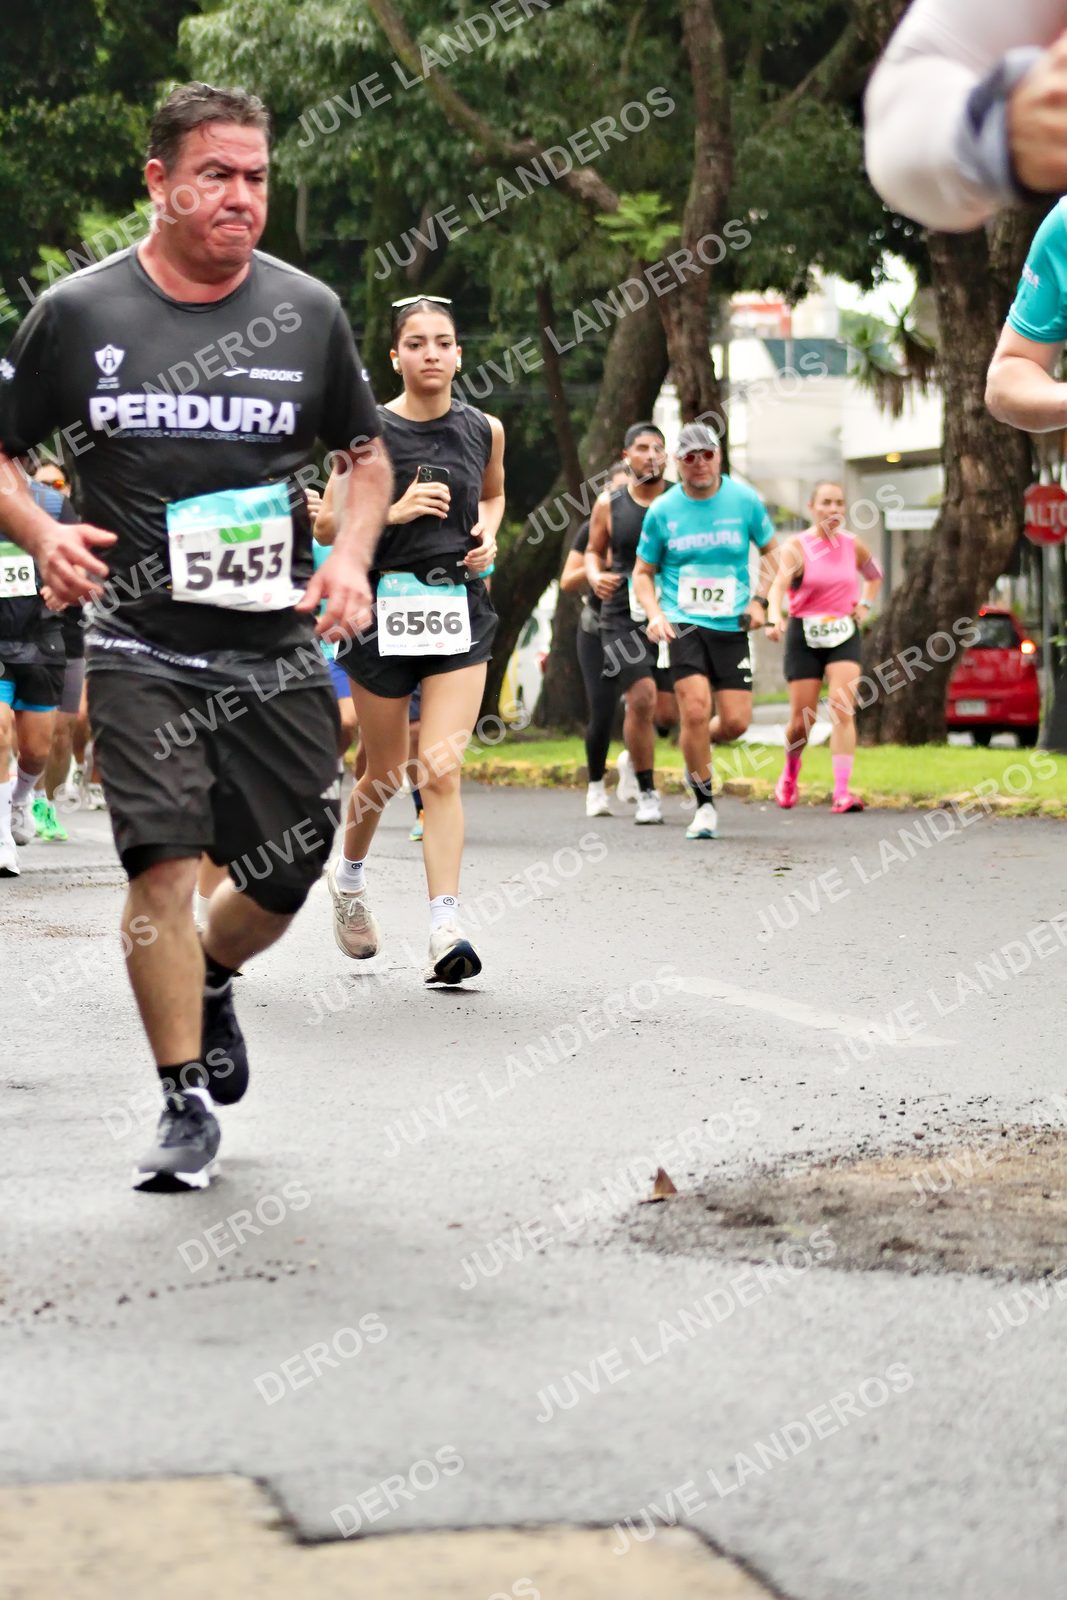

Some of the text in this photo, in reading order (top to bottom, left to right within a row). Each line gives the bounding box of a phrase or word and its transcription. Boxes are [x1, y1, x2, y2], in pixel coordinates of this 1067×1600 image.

[249, 368, 304, 382] BROOKS
[89, 393, 295, 435] PERDURA
[185, 542, 285, 591] 5453
[690, 587, 724, 602] 102
[386, 611, 463, 636] 6566
